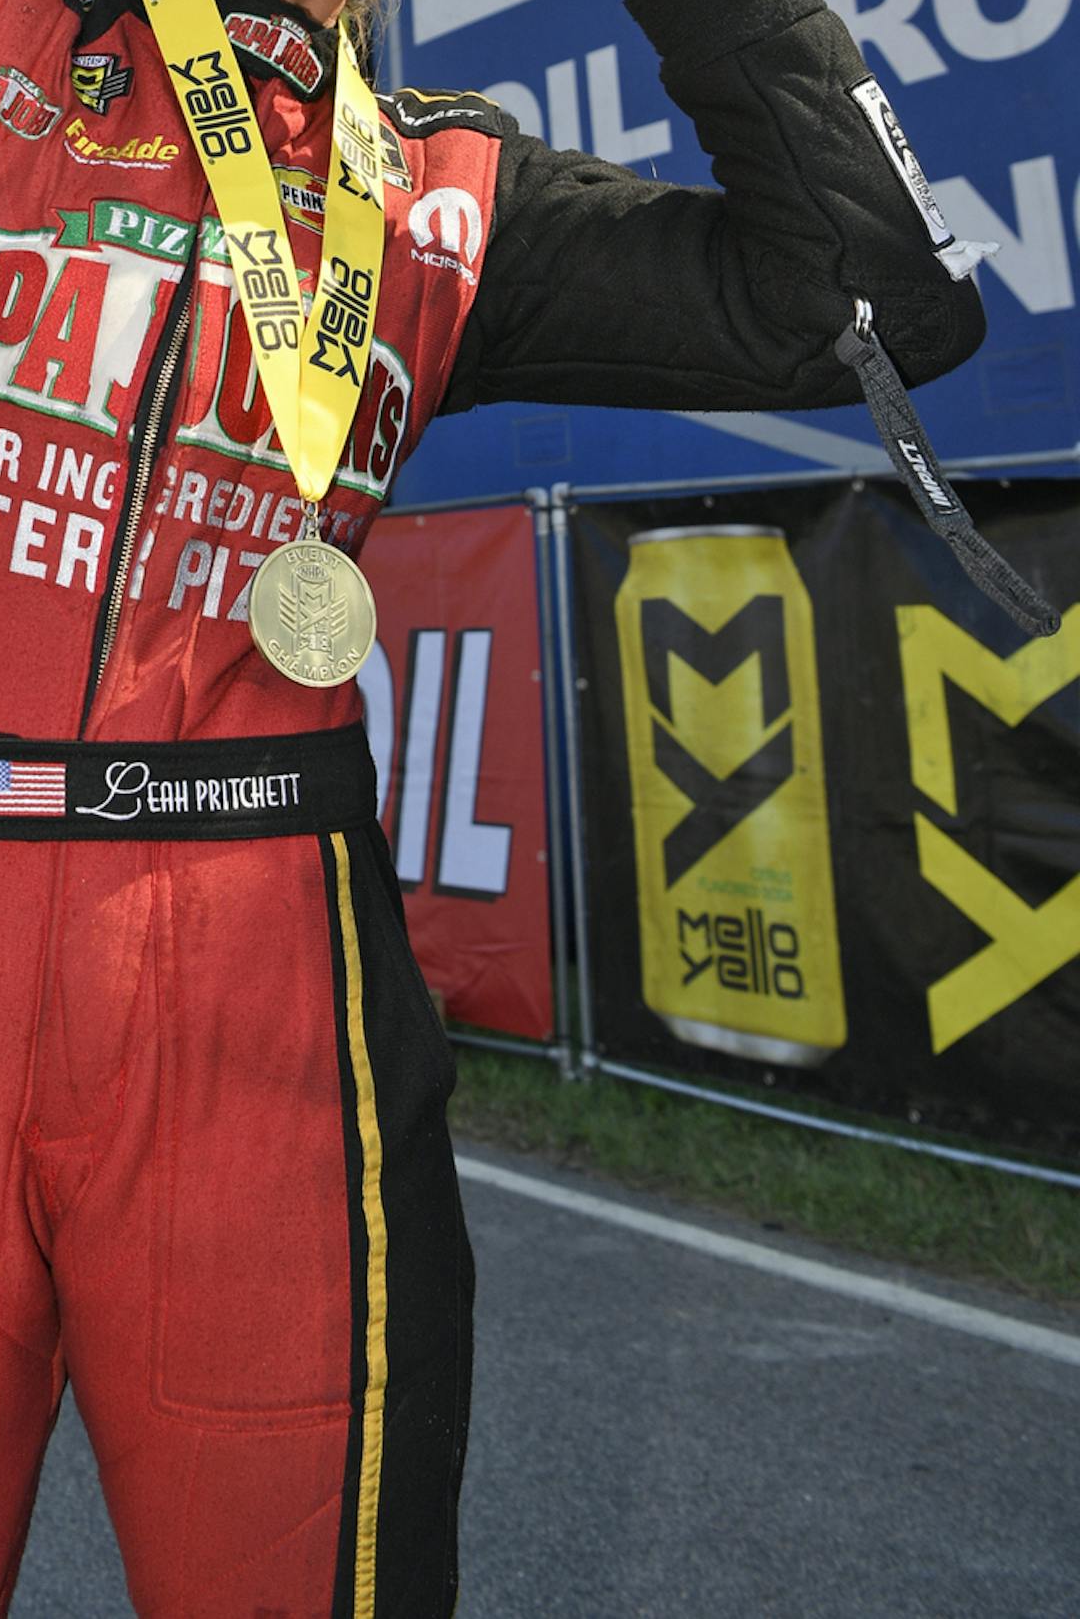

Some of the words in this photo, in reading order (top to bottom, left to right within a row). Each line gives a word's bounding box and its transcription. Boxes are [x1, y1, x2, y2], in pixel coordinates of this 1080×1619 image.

[226, 16, 281, 59] PAPA
[65, 117, 180, 160] FireAde
[281, 183, 327, 213] PENN
[410, 247, 479, 286] MOPAR
[167, 537, 270, 623] PIZ
[285, 546, 342, 571] EVENT
[267, 637, 362, 681] CHAMPION
[360, 629, 513, 895] IL
[195, 772, 301, 813] PRITCHETT
[677, 907, 800, 961] Mello
[679, 949, 805, 1000] Yello
